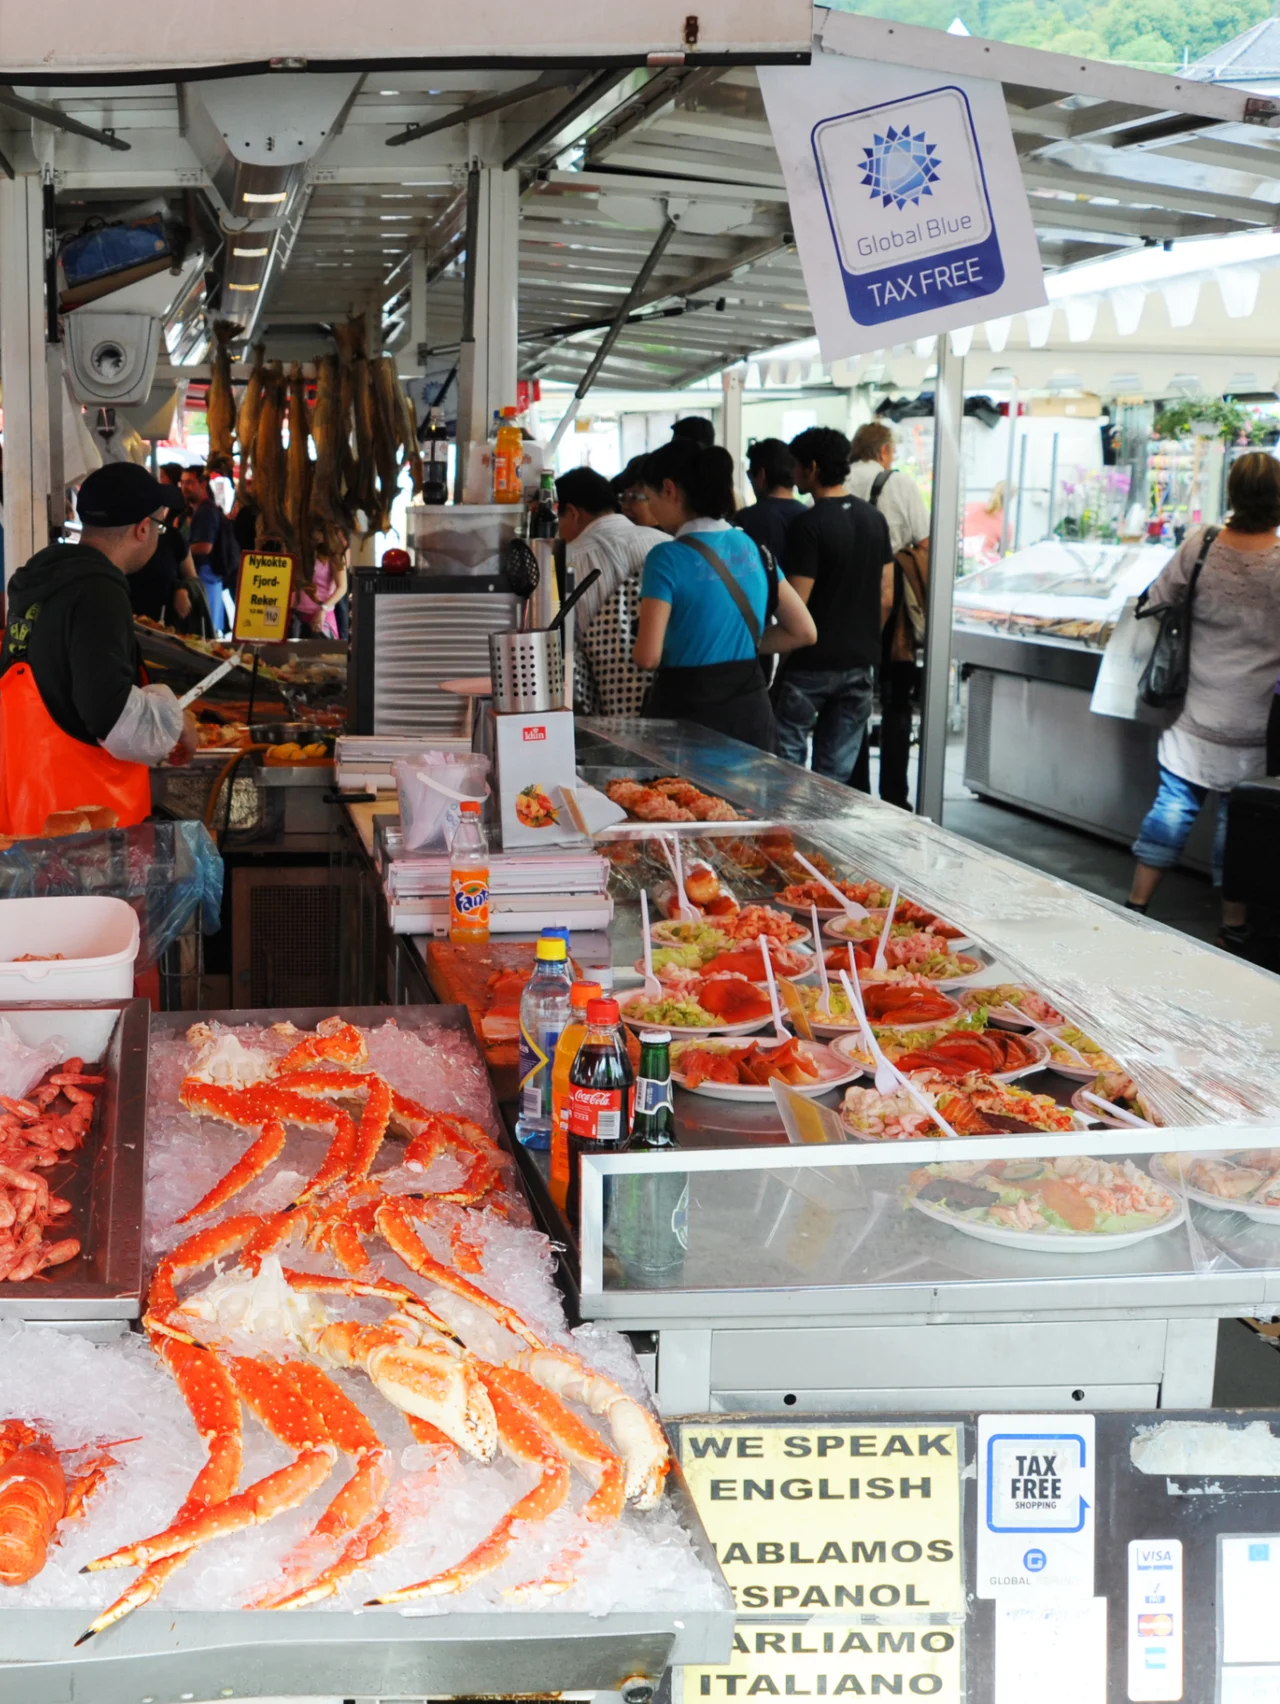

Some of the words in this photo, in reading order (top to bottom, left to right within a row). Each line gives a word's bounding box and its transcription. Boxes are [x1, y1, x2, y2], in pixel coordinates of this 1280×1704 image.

[857, 224, 922, 257] Global
[926, 215, 973, 240] Blue
[867, 275, 918, 308] TAX
[919, 257, 983, 295] FREE
[249, 556, 287, 569] Nykokte
[253, 575, 279, 588] Fjord-
[250, 595, 278, 606] Reker
[689, 1436, 764, 1458] WE
[783, 1434, 952, 1458] SPEAK
[1015, 1455, 1057, 1477] TAX
[710, 1477, 932, 1501] ENGLISH
[1011, 1478, 1062, 1500] FREE
[1015, 1501, 1057, 1510] SHOPPING
[713, 1540, 955, 1565] ABLAMOS
[1140, 1550, 1171, 1561] VISA
[989, 1576, 1031, 1586] GLOBAL
[730, 1631, 955, 1654] ARLIAMO
[699, 1673, 943, 1696] ITALIANO
